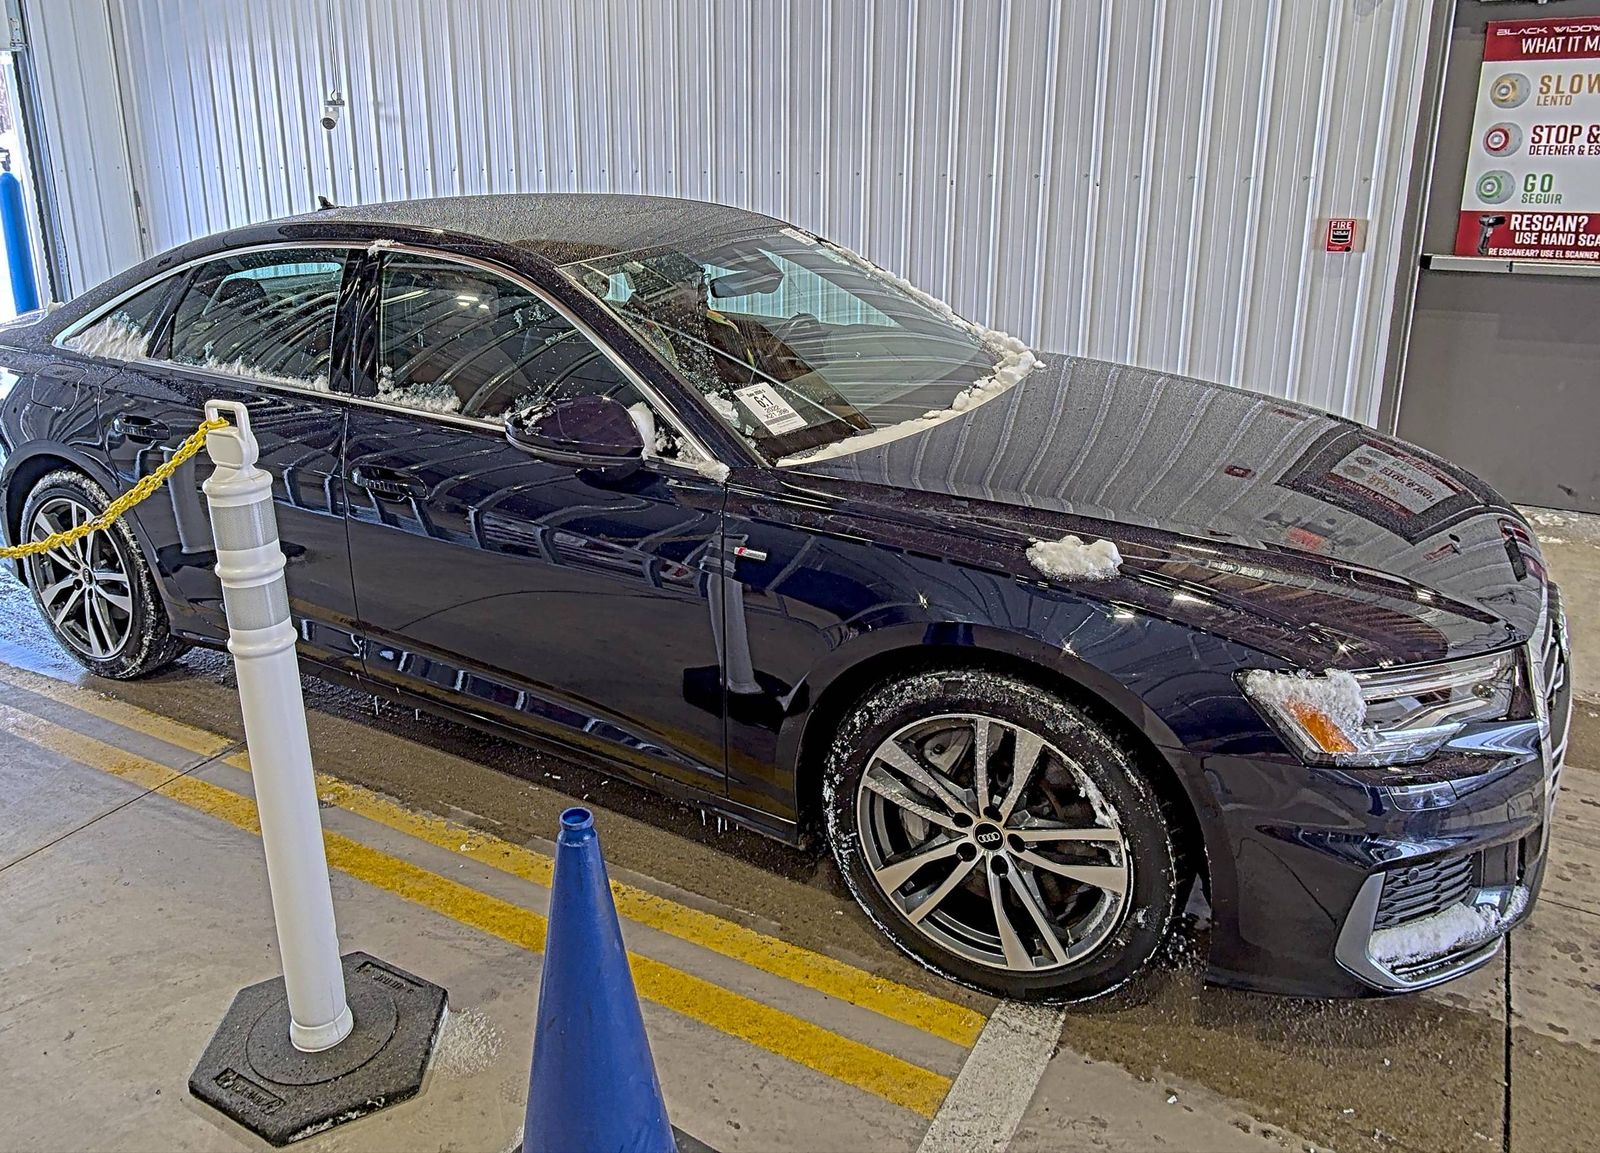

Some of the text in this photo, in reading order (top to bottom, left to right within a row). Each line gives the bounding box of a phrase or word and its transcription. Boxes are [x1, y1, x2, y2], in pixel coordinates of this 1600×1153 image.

[1496, 26, 1548, 36] BLACK
[1521, 35, 1600, 54] WHAT IT M
[1536, 95, 1573, 107] LENTO
[1531, 124, 1600, 144] STOP &
[1528, 145, 1576, 156] DETENER
[1577, 145, 1586, 156] &
[1523, 173, 1554, 193] GO
[1521, 193, 1562, 204] SEGUIR
[1331, 221, 1352, 229] FIRE
[1509, 214, 1589, 232] RESCAN?
[1514, 232, 1538, 245] USE
[1540, 232, 1576, 246] HAND
[1488, 248, 1600, 259] RE ESCANEAR? USE EL SCANNER
[753, 394, 774, 408] 6:1
